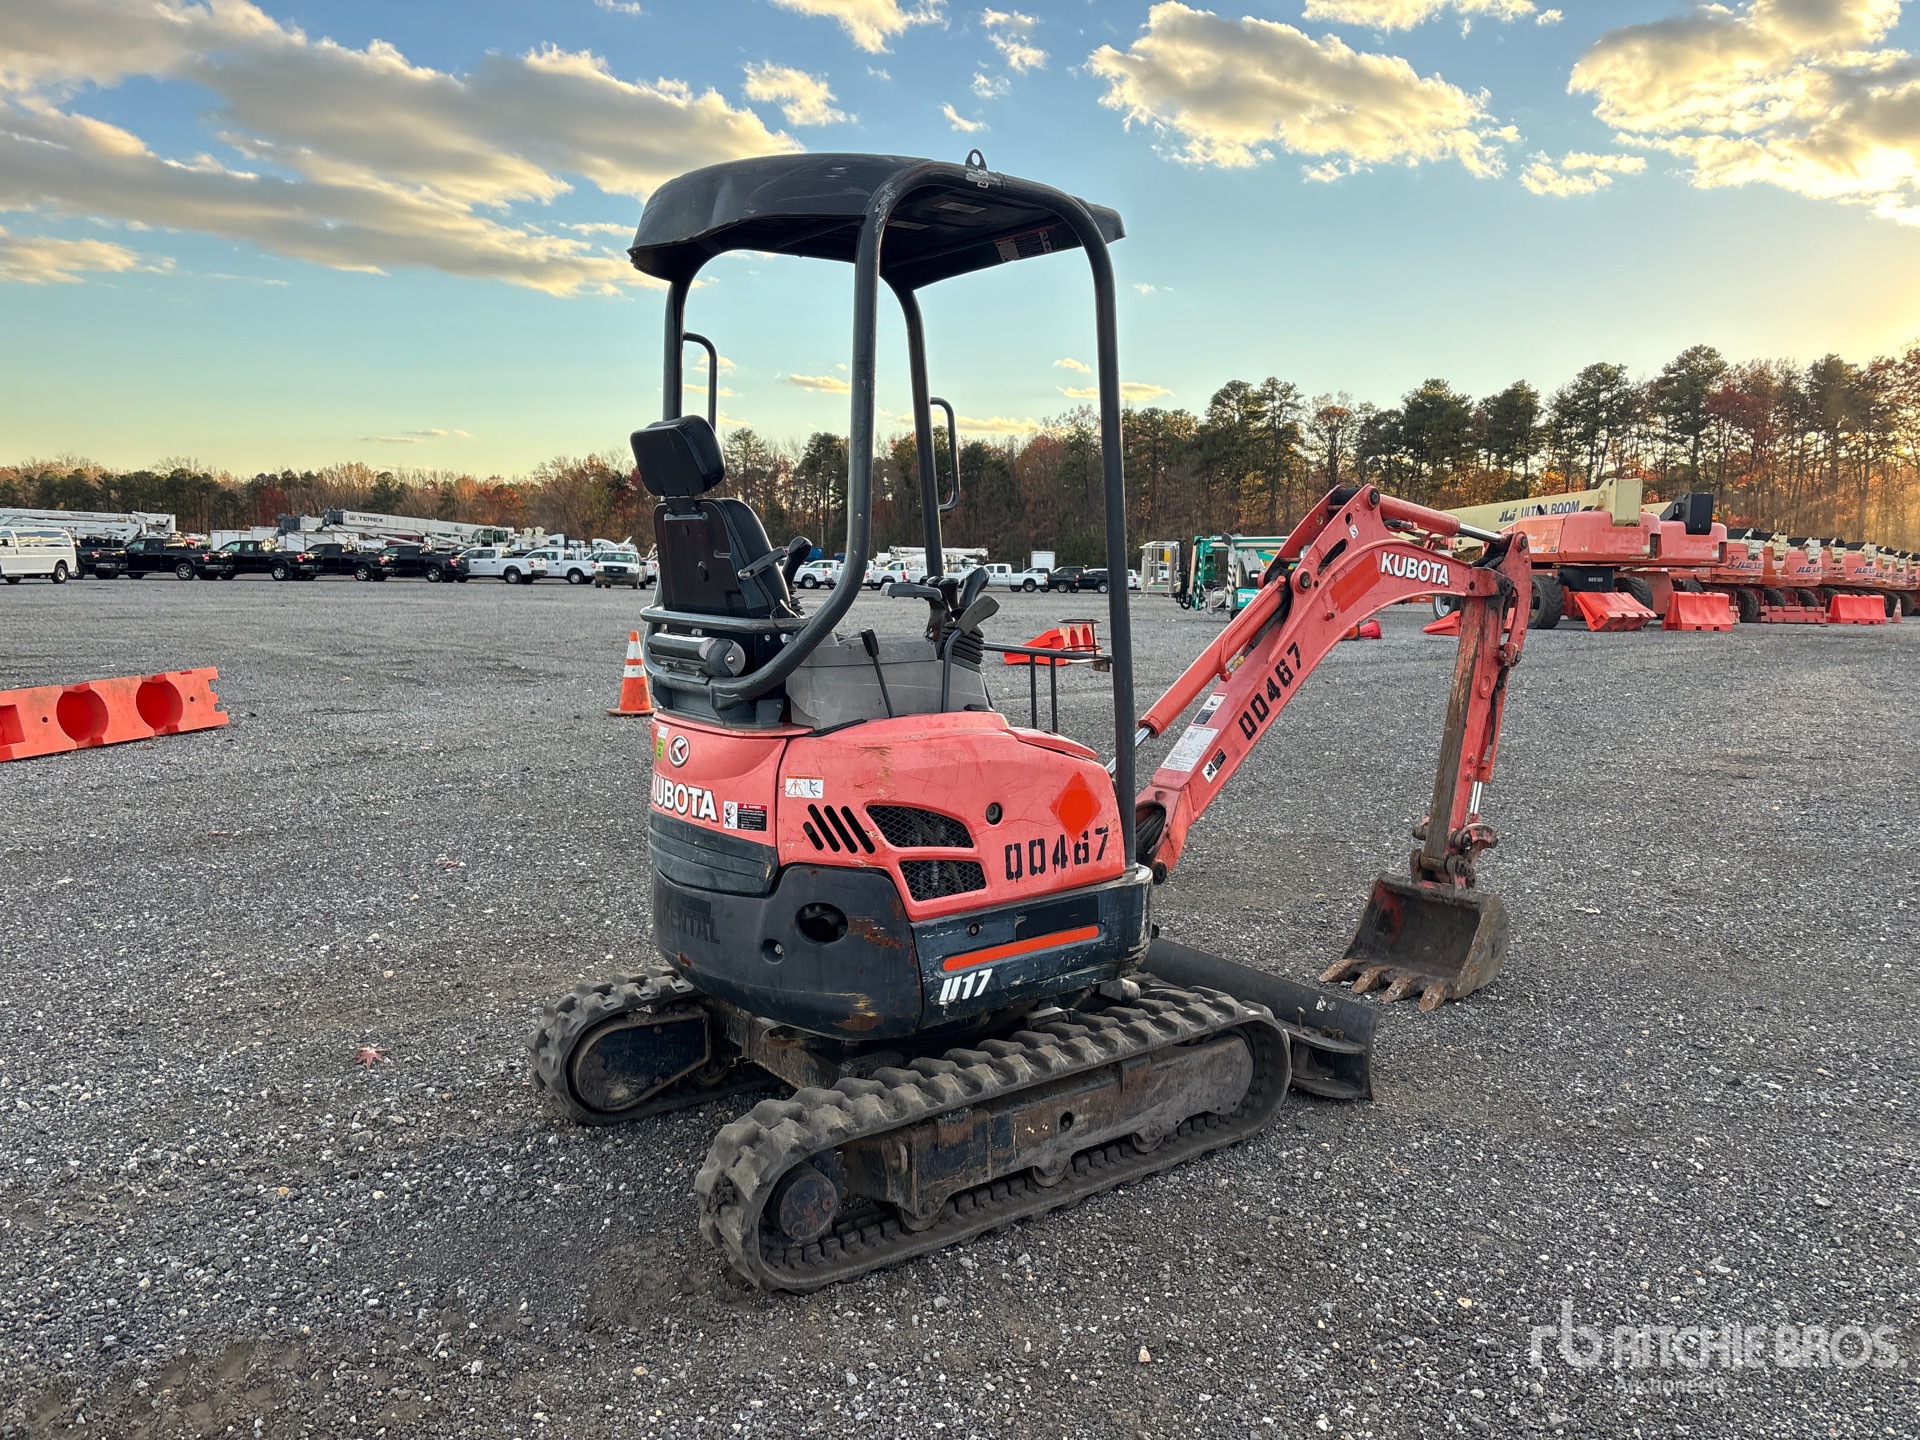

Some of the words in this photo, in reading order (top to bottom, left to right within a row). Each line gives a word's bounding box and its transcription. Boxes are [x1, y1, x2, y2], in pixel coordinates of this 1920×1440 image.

[1521, 504, 1548, 518] ULTA
[1551, 500, 1580, 514] BOOM
[1380, 551, 1450, 587] KUBOTA
[1238, 641, 1301, 740] 00467
[652, 774, 719, 822] KUBOTA
[1005, 826, 1109, 881] 00467
